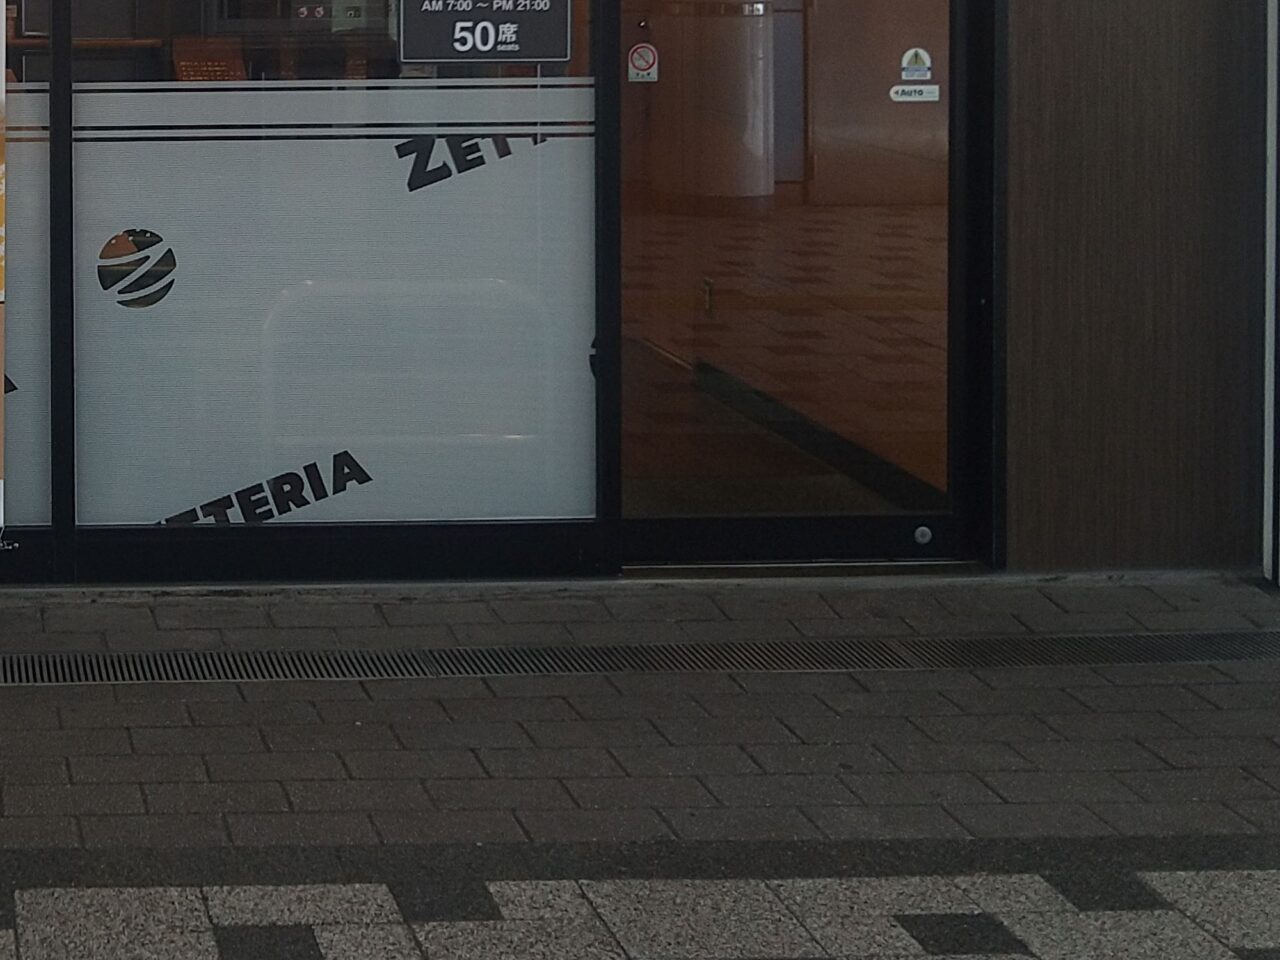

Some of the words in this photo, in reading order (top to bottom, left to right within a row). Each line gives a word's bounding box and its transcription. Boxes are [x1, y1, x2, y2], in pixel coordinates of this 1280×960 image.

[421, 0, 443, 11] AM
[446, 0, 473, 11] 7:00
[493, 0, 514, 11] PM
[516, 0, 550, 11] 21:00
